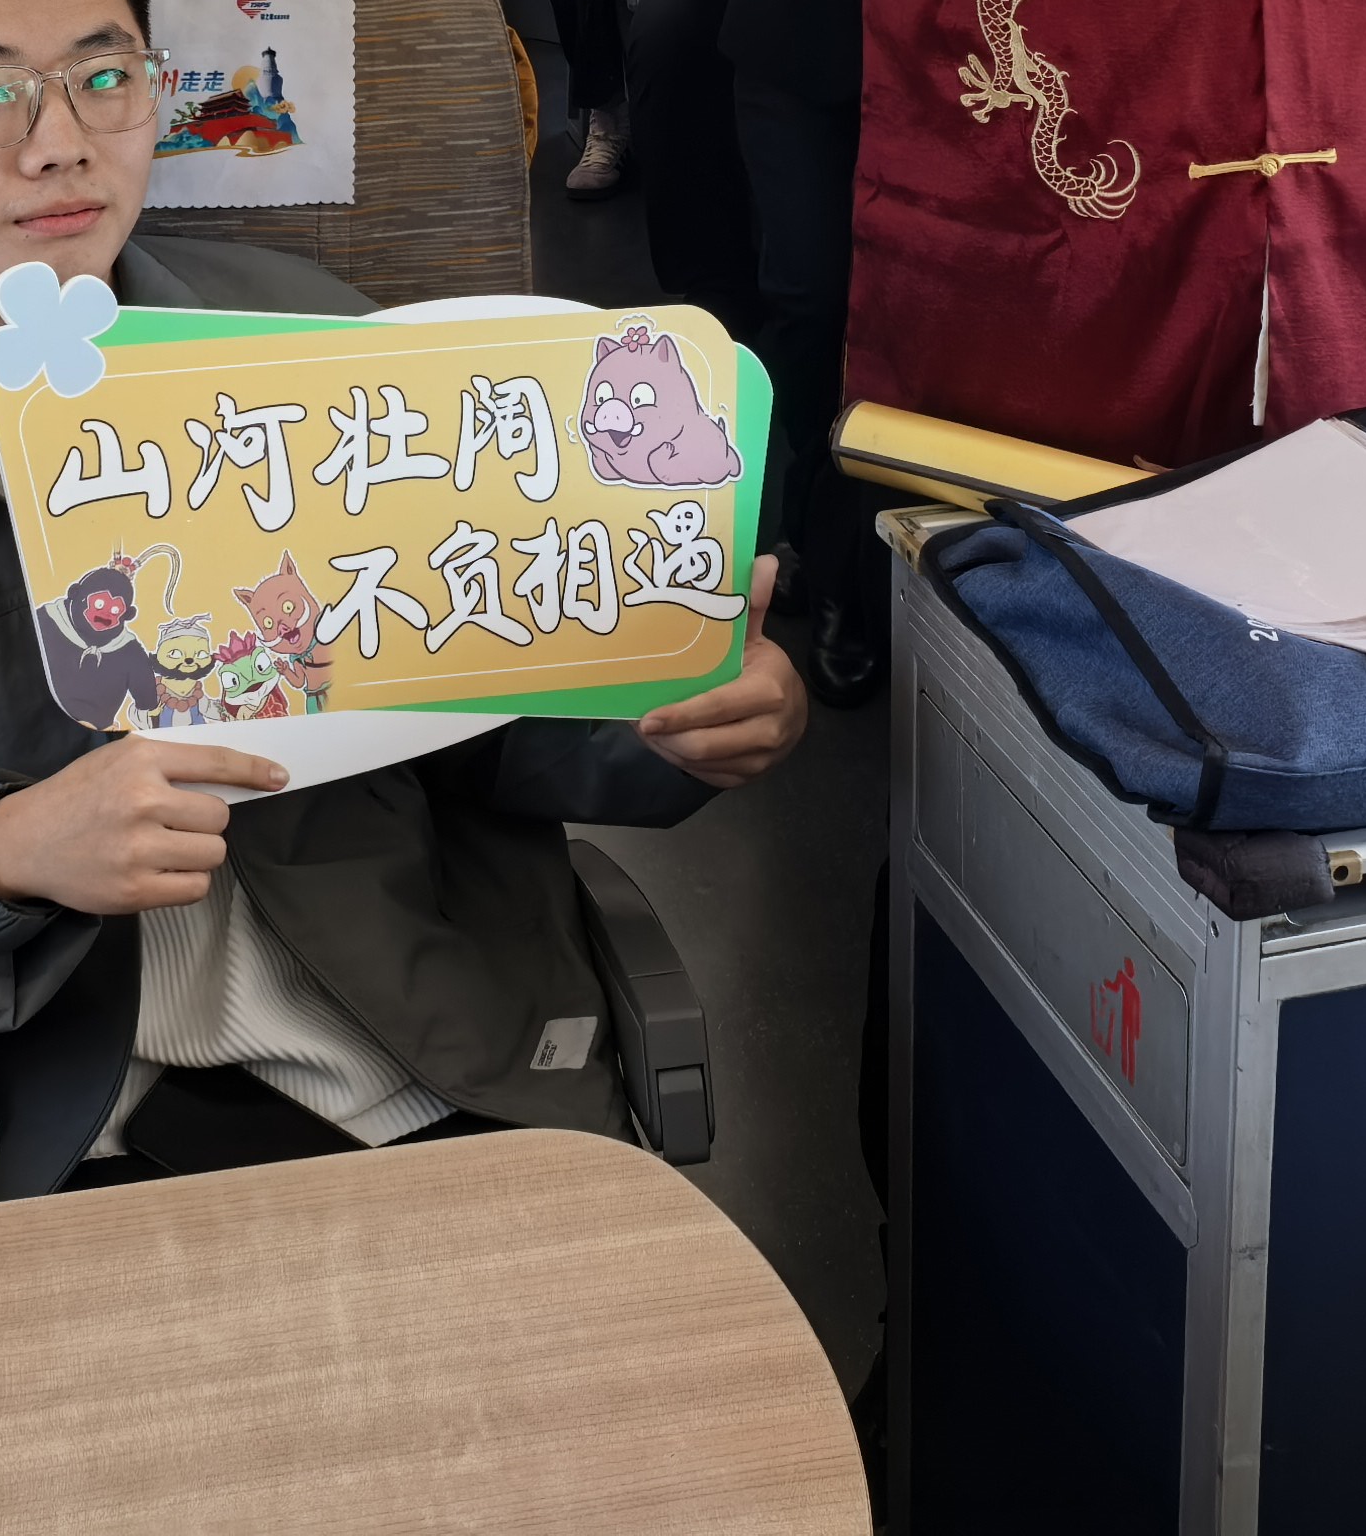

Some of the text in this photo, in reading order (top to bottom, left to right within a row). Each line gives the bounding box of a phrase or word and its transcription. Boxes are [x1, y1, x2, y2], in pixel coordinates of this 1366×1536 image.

[46, 374, 563, 532] 山河壮阔
[316, 500, 746, 659] 不负相遇
